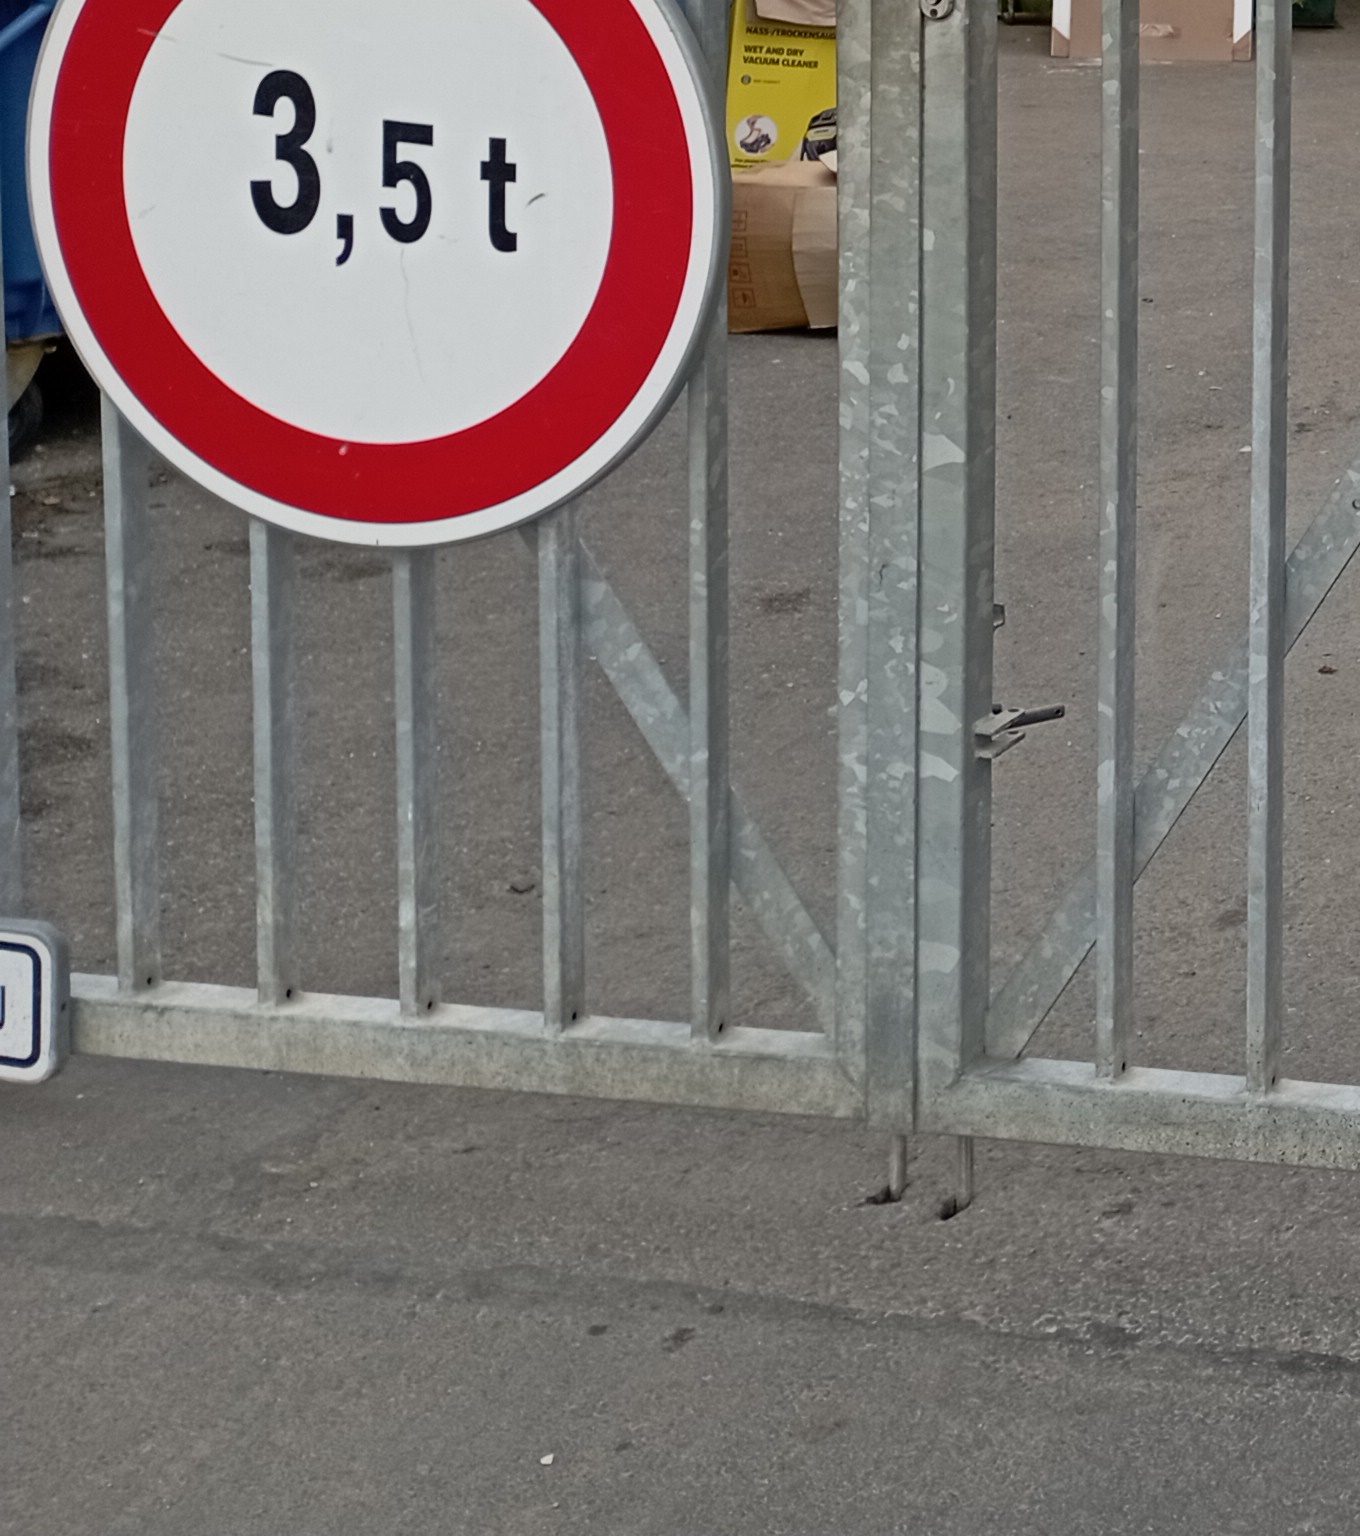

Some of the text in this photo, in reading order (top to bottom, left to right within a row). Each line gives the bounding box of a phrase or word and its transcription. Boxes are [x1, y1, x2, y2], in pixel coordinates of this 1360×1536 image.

[743, 56, 819, 69] VACUUM CLEANER
[250, 70, 517, 266] 3,5 t
